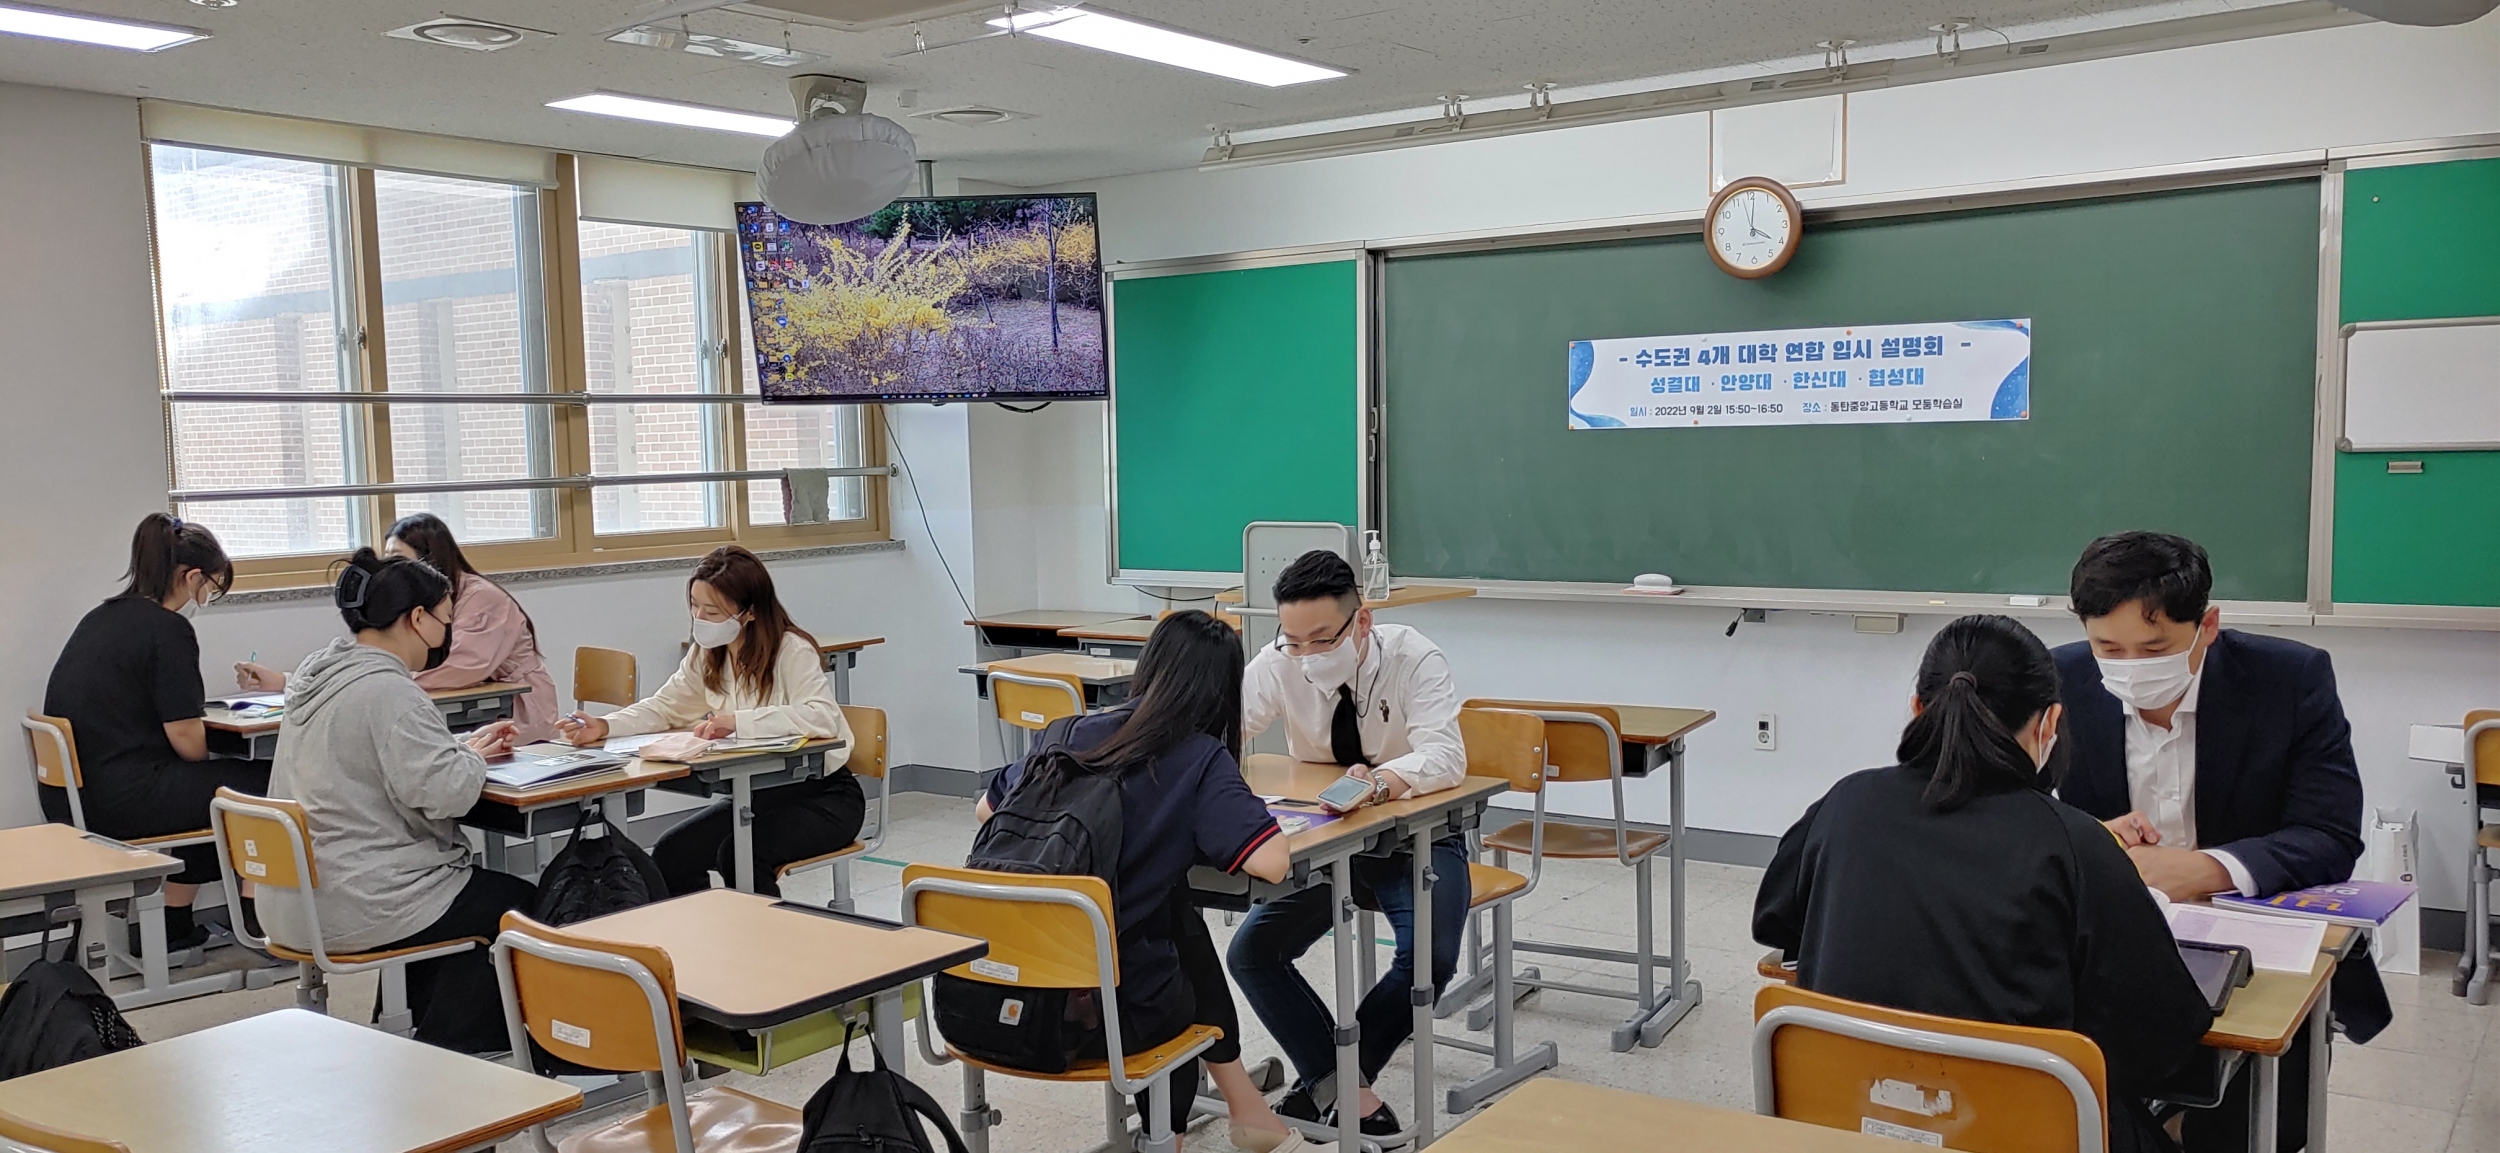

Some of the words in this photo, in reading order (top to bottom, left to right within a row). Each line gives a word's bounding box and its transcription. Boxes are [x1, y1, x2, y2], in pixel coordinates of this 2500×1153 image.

[1746, 192, 1755, 200] 12
[1766, 194, 1769, 203] 1
[1732, 198, 1740, 208] 11
[1776, 204, 1782, 213] 2
[1722, 210, 1731, 220] 10
[1782, 220, 1788, 228] 3
[1718, 228, 1725, 236] 9
[1778, 236, 1784, 245] 4
[1725, 243, 1731, 251] 8
[1736, 253, 1741, 262] 7
[1768, 249, 1774, 258] 5
[1751, 255, 1758, 264] 6
[1636, 347, 1690, 368] 수도권
[1697, 346, 1730, 366] 4개
[1738, 344, 1778, 364] 대학
[1785, 341, 1825, 362] 연합
[1833, 339, 1872, 360] 입시
[1881, 336, 1943, 358] 설명회
[1651, 376, 1700, 394] 성결대
[1720, 373, 1772, 392] 안양대
[1793, 370, 1846, 389] 한신대
[1868, 368, 1924, 387] 협성대
[1630, 406, 1647, 416] 일시
[1655, 406, 1687, 416] 2022년
[1690, 405, 1704, 415] 9월
[1707, 404, 1722, 415] 2일
[1725, 404, 1783, 414] 15:50~16:50
[1802, 402, 1821, 413] 장소
[1830, 400, 1908, 412] 동탄중앙고등학교
[1912, 398, 1962, 410] 모둠학습실
